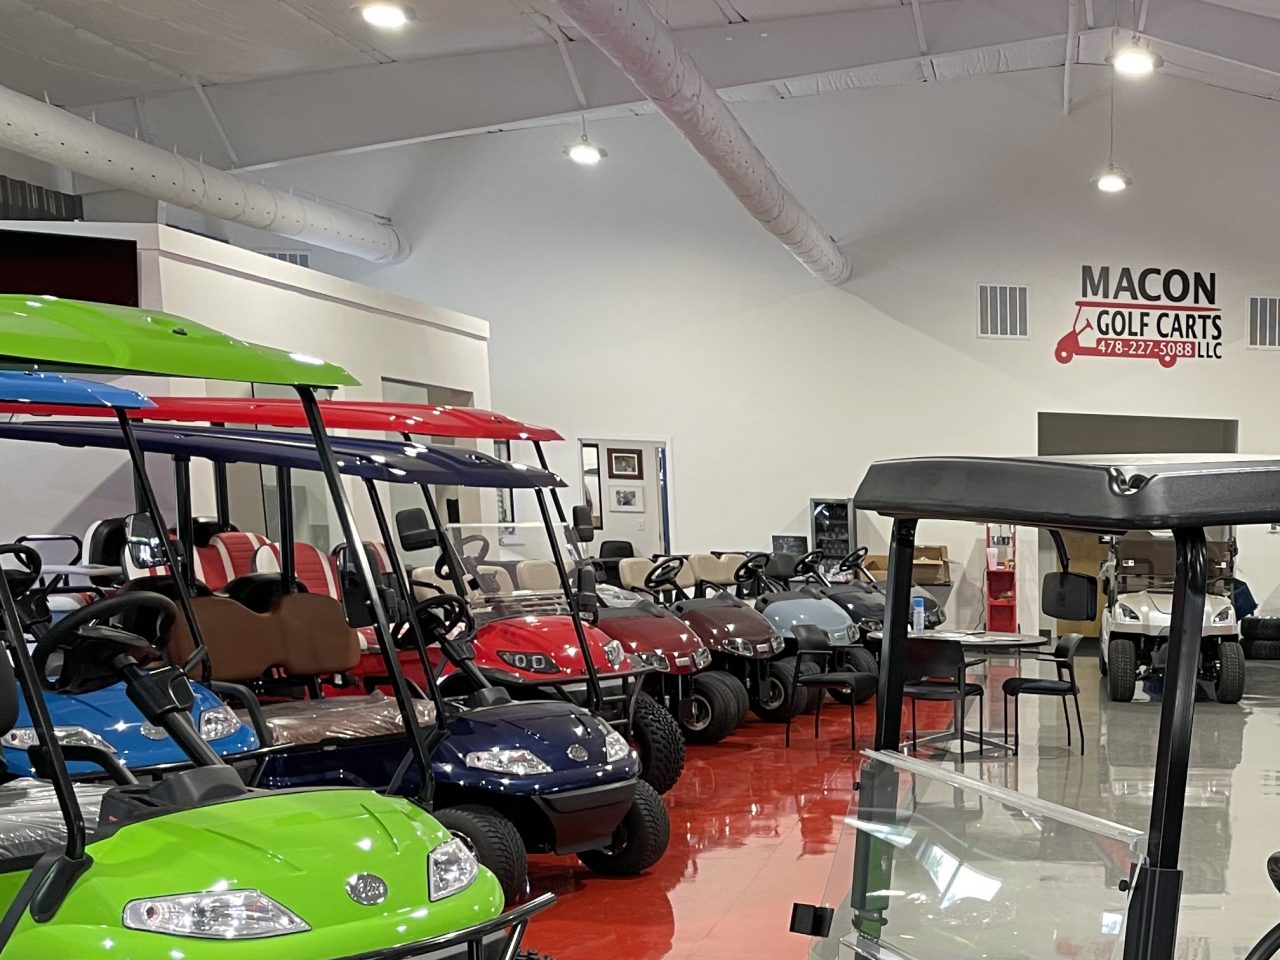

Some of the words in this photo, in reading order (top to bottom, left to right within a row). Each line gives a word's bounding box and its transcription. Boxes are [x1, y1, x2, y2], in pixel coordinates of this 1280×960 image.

[1081, 265, 1216, 305] MACON
[1096, 309, 1150, 337] GOLF
[1156, 312, 1222, 340] CARTS
[1097, 340, 1193, 356] 478-227-5088
[1197, 341, 1222, 359] LLC
